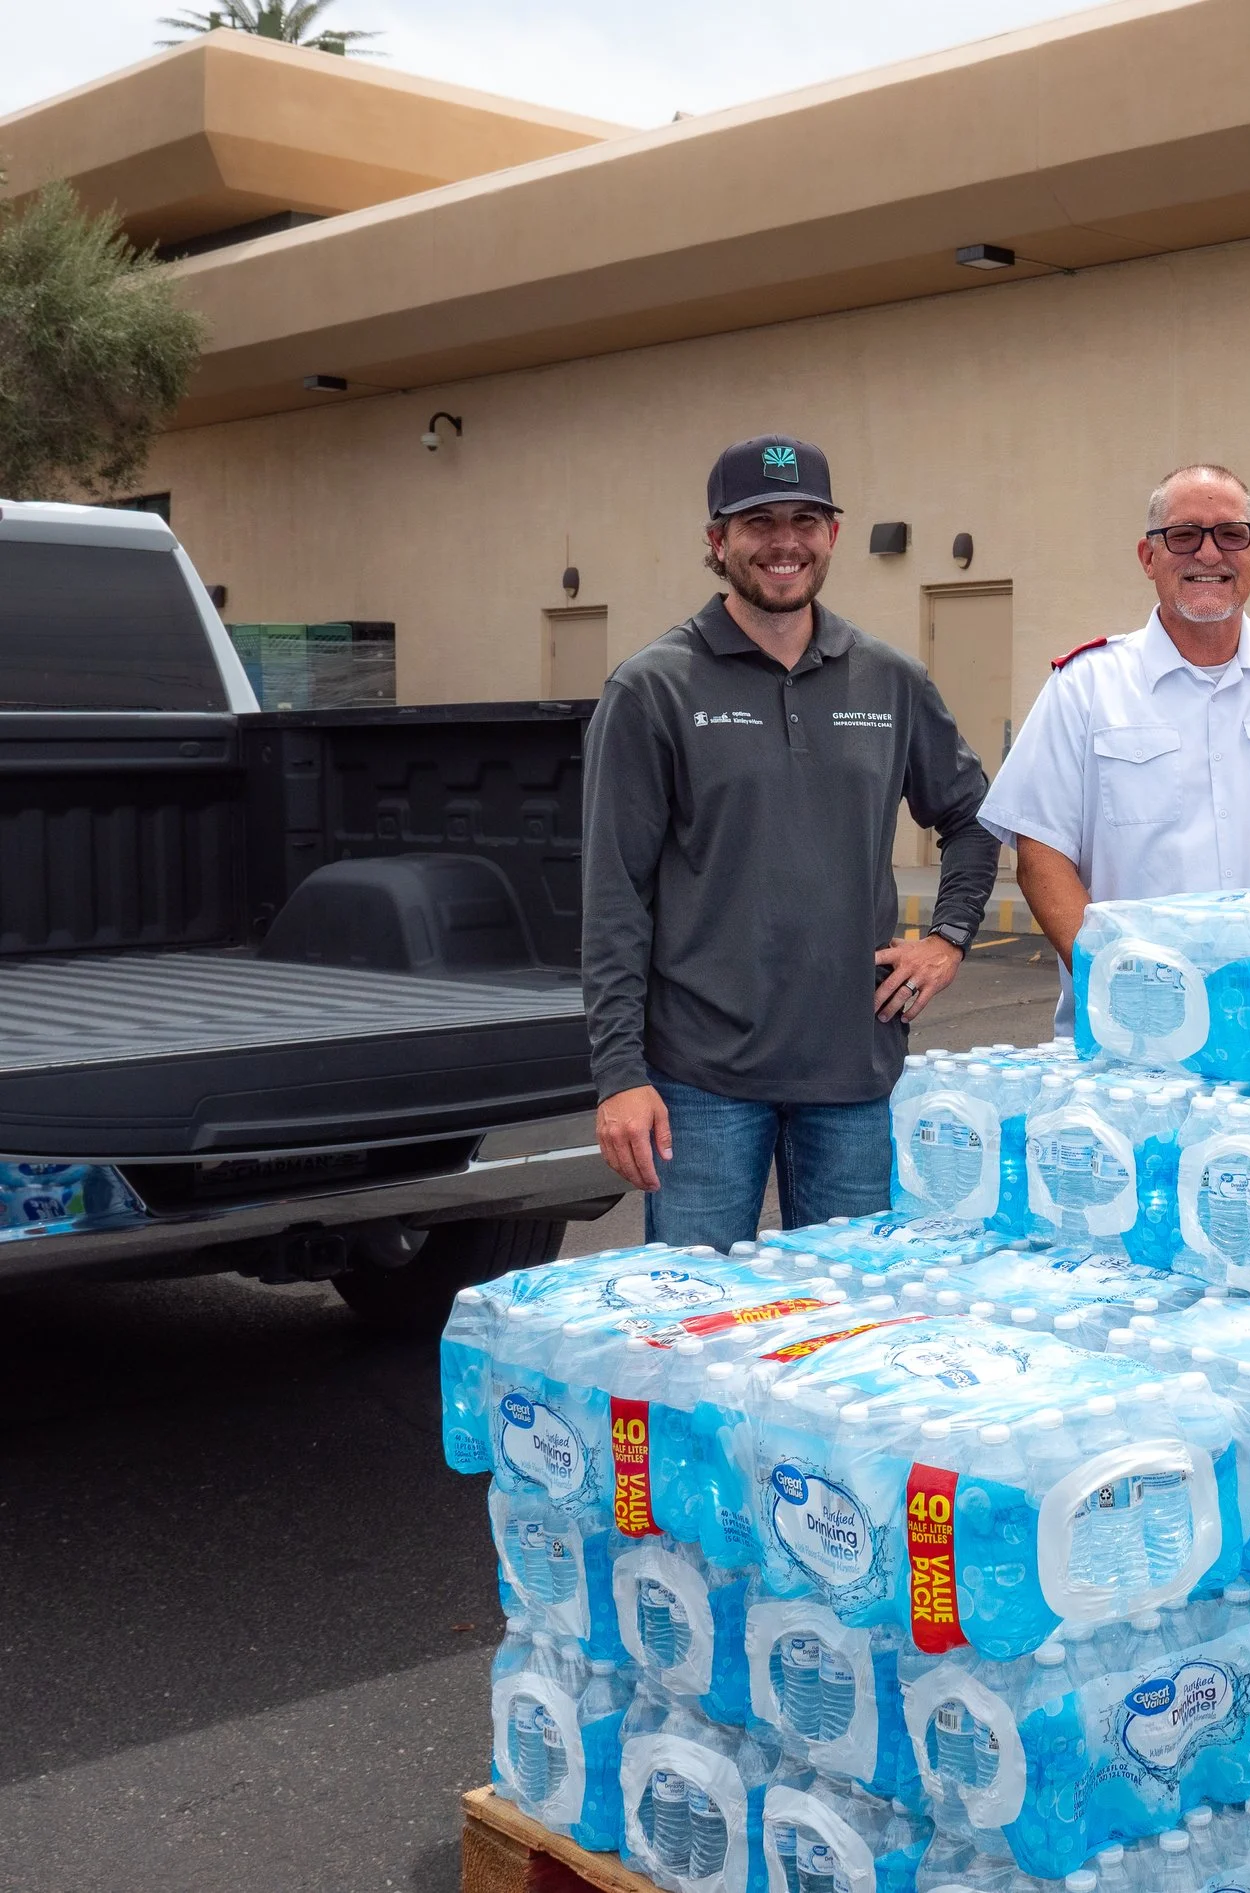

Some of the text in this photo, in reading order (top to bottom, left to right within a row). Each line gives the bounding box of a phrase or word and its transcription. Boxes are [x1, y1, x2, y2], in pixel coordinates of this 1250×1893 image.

[867, 713, 893, 721] SEWER
[505, 1400, 531, 1416] Great
[512, 1410, 532, 1423] Value
[612, 1418, 646, 1445] 40
[533, 1435, 571, 1467] Drinking
[615, 1452, 644, 1464] BOTTLES
[628, 1445, 649, 1455] LITER
[544, 1455, 572, 1479] Water
[775, 1470, 803, 1490] Great
[615, 1472, 630, 1531] PACK
[629, 1472, 650, 1532] VALUE
[783, 1484, 804, 1500] Value
[822, 1505, 856, 1528] Purified
[908, 1491, 951, 1524] 40
[806, 1512, 859, 1549] Drinking
[908, 1520, 953, 1535] HALF LITER
[912, 1531, 948, 1544] BOTTLES
[820, 1535, 860, 1563] Water
[912, 1555, 932, 1622] PACK
[929, 1554, 955, 1624] VALUE
[1132, 1684, 1171, 1705] Great
[1183, 1672, 1216, 1697] Purified
[1142, 1696, 1171, 1711] Value
[1181, 1699, 1218, 1727] Water
[1111, 1763, 1129, 1772] FL OZ
[1108, 1771, 1117, 1779] 12
[1121, 1771, 1143, 1787] TOTAL
